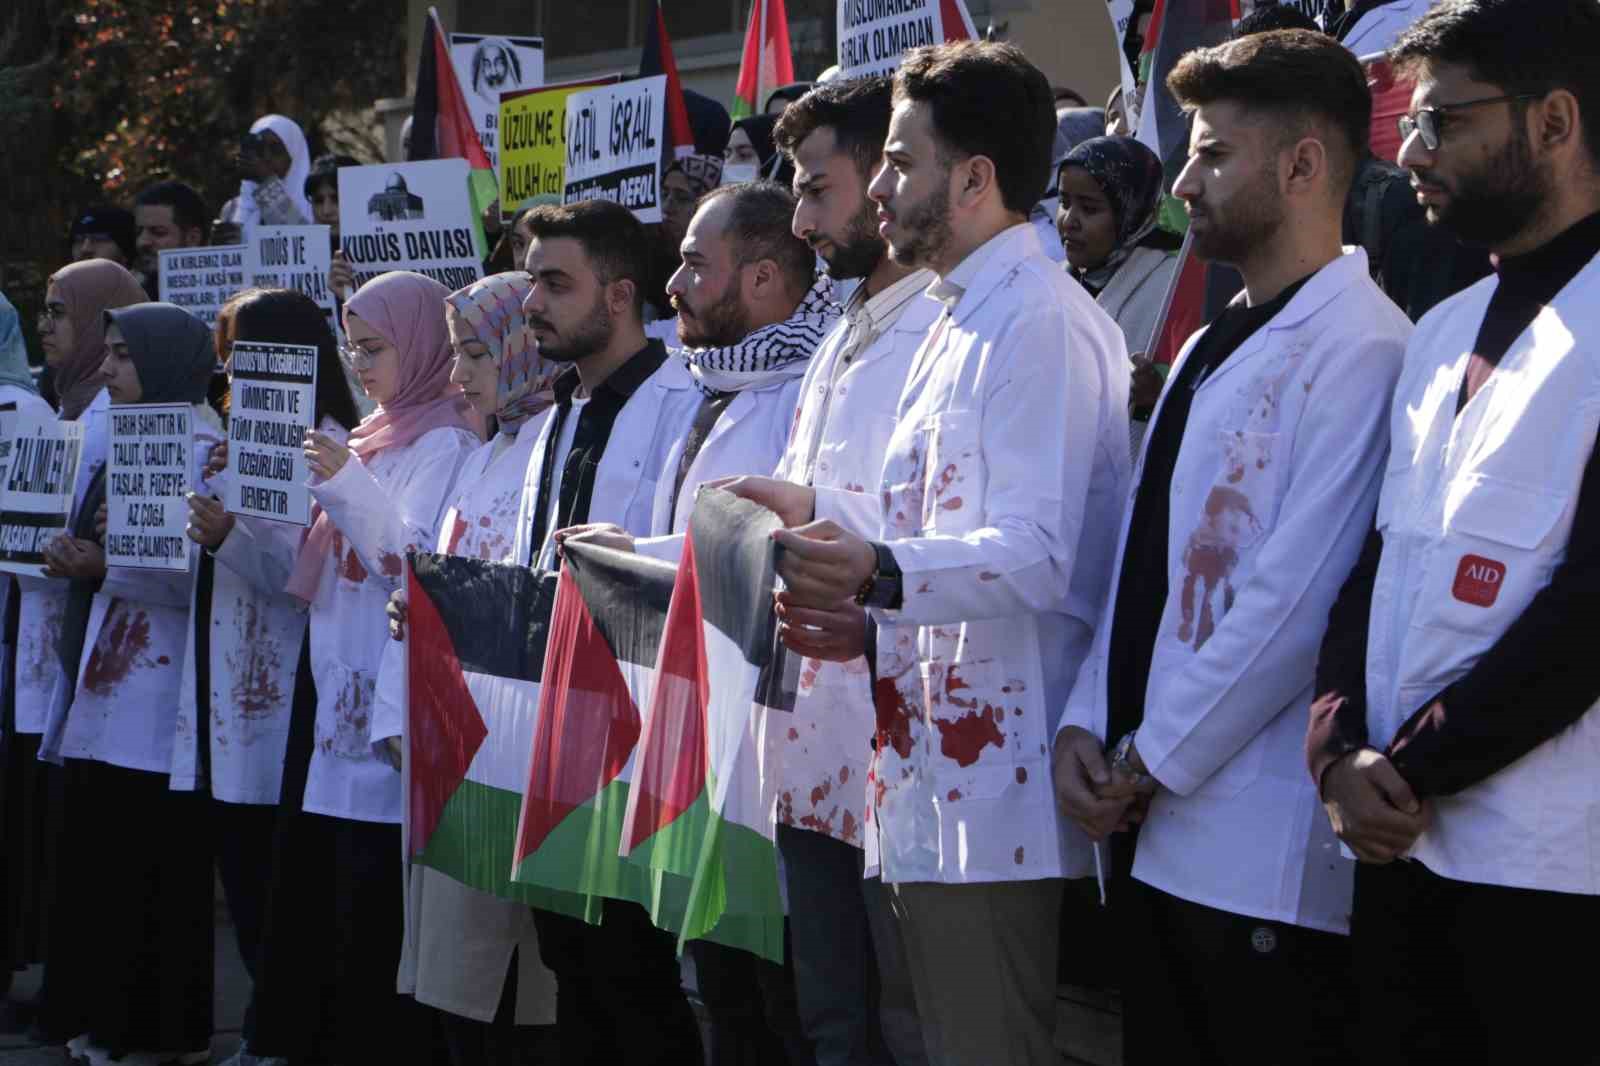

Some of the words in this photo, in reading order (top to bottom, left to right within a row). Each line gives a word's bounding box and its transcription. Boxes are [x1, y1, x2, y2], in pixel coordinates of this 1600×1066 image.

[873, 16, 934, 60] OLMADAN
[503, 105, 556, 151] ÜZÜLME,
[609, 87, 655, 160] İSRAİL
[505, 160, 540, 202] ALLAH
[620, 173, 655, 206] DEFOL
[222, 253, 242, 267] OLAN
[292, 236, 306, 265] VE
[342, 226, 401, 264] KUDÜS
[404, 228, 475, 261] DAVASI
[241, 385, 284, 413] ÜMMETİN
[288, 390, 300, 414] VE
[231, 416, 252, 441] TÜM
[238, 447, 293, 482] ÖZGÜRLÜĞÜ
[127, 503, 139, 526] AZ
[240, 485, 288, 514] DEMEKTİR
[109, 534, 136, 556] GALEBE
